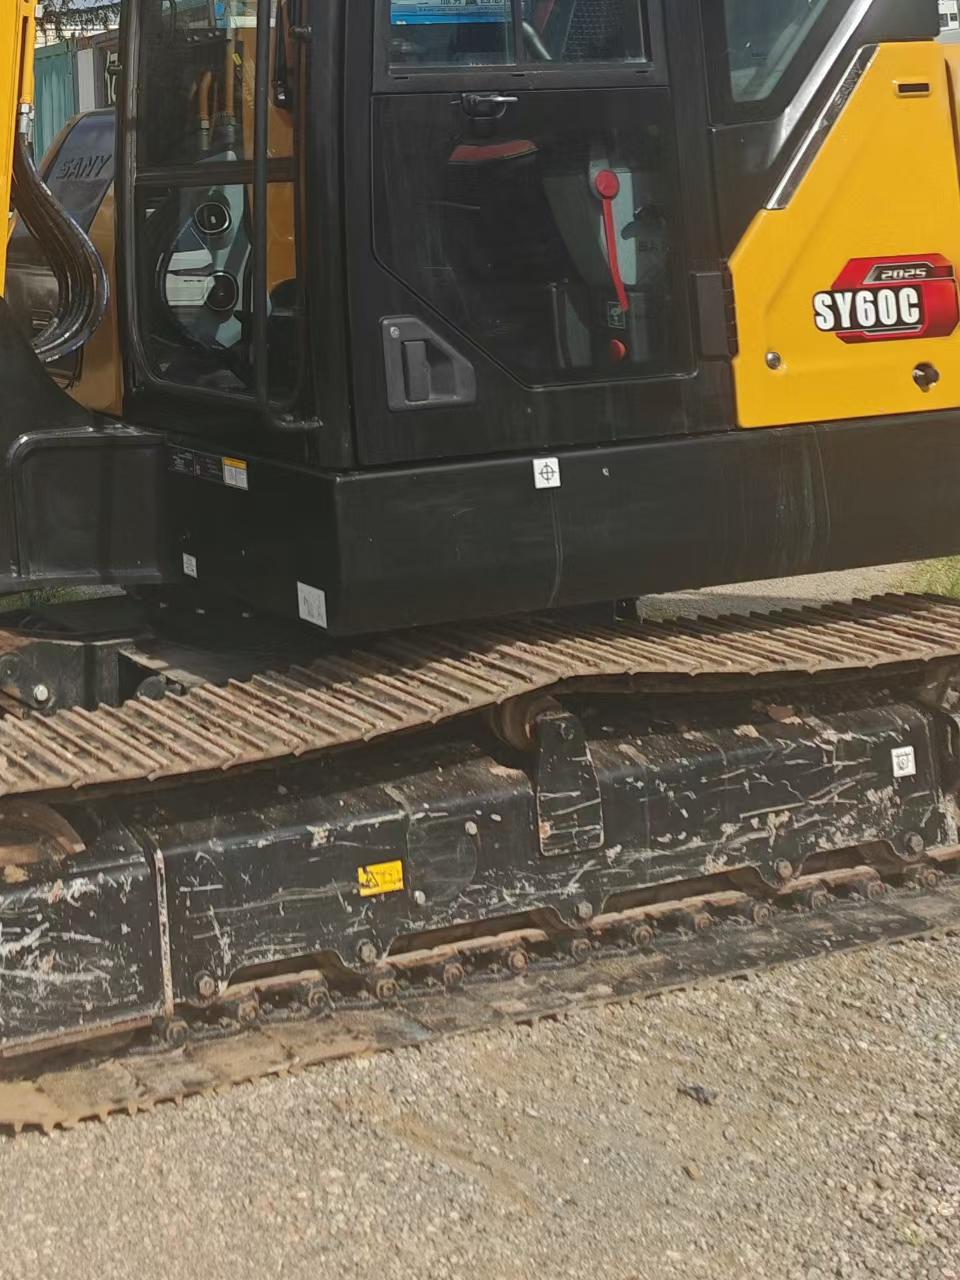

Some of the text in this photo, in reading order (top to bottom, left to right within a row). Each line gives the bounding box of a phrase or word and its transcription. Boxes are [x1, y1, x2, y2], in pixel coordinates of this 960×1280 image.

[56, 154, 112, 180] SANY
[881, 268, 927, 280] 2025
[813, 287, 920, 330] SY60C
